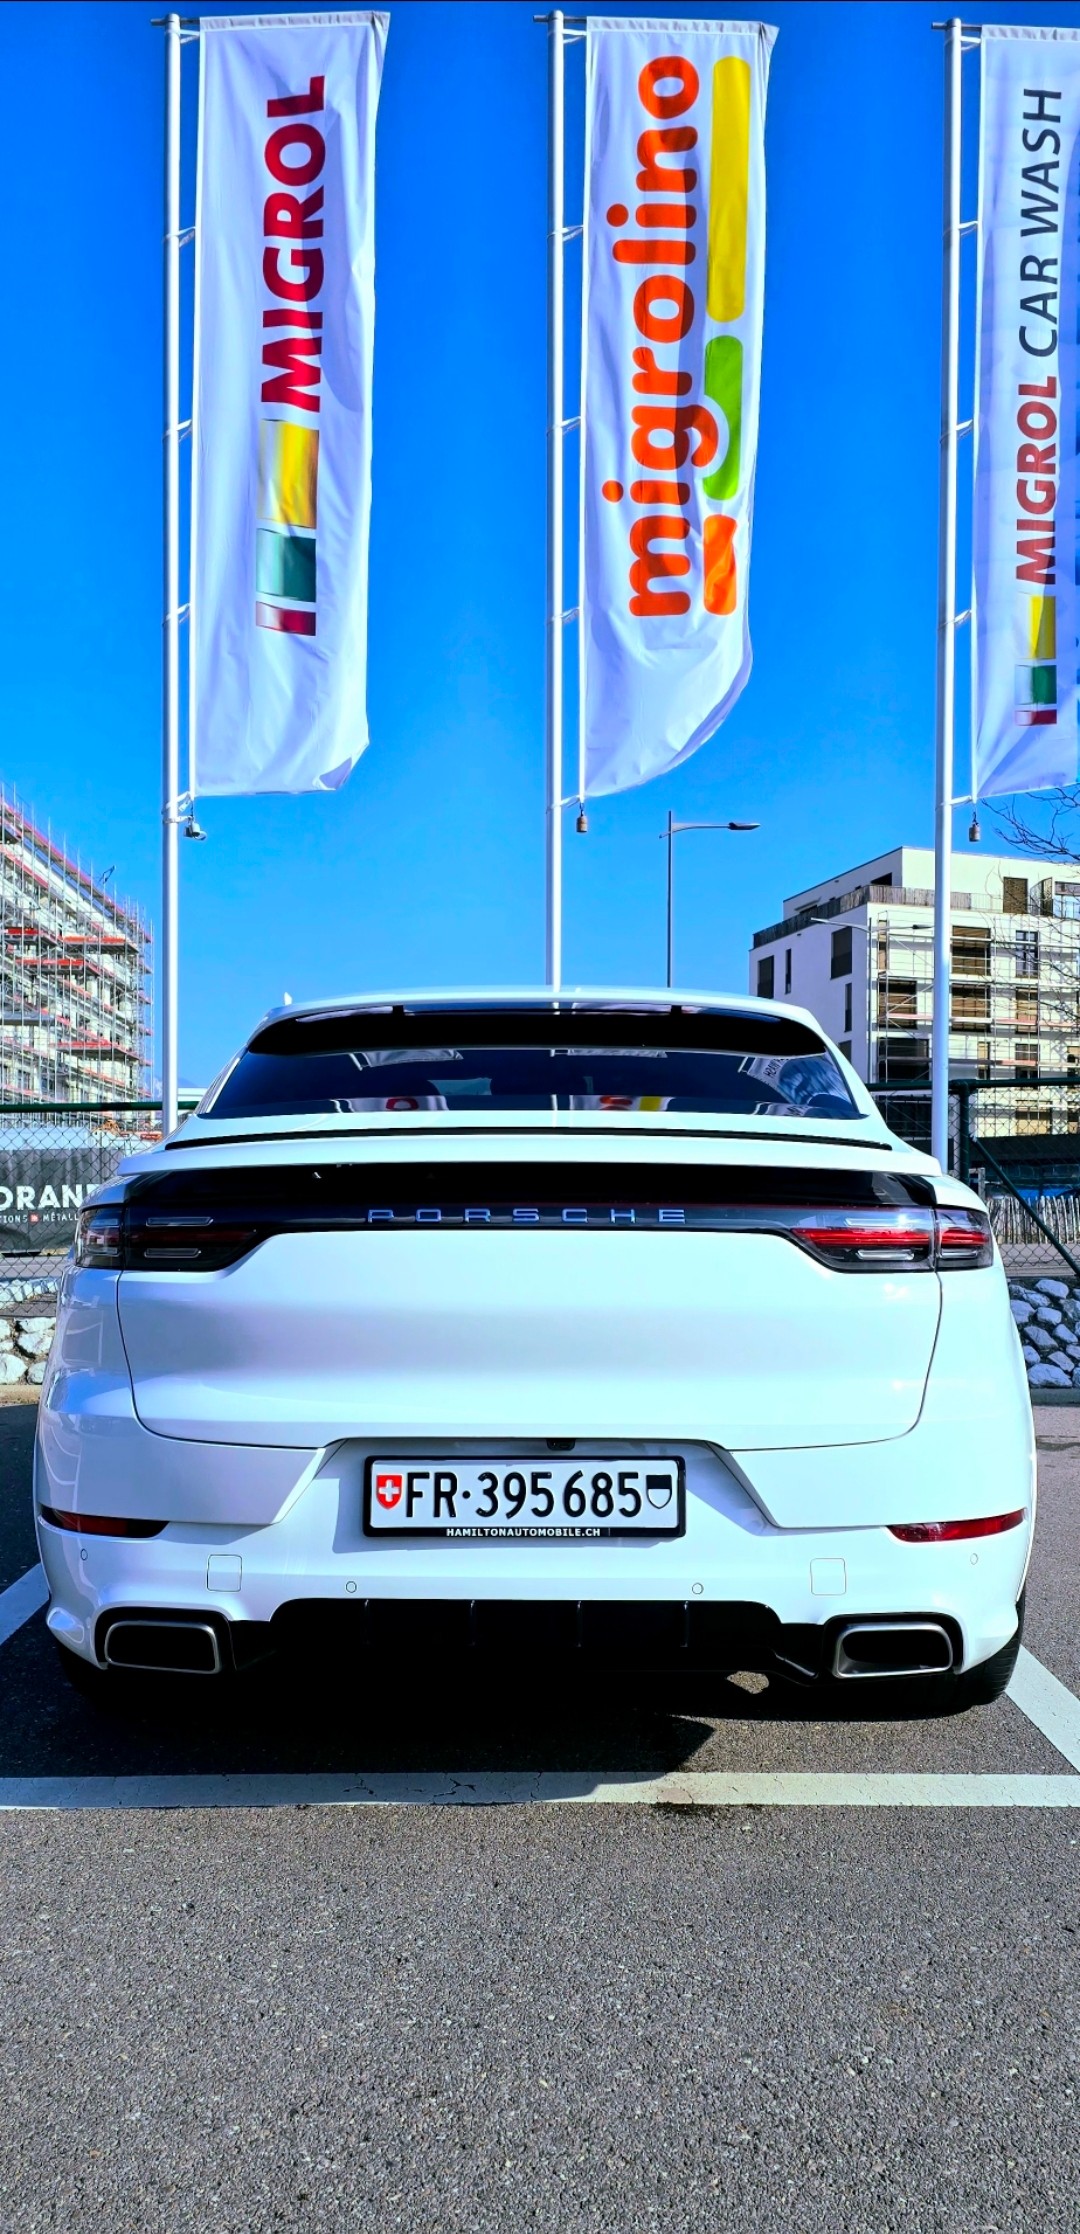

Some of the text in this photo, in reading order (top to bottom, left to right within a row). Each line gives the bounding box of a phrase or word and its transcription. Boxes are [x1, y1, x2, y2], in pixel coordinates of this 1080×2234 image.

[261, 75, 325, 413] MIGROL
[602, 56, 719, 617] migrolino
[1016, 88, 1062, 585] MIGROL CAR WASH
[367, 1208, 686, 1223] PORSCHE
[446, 1528, 601, 1537] HAMILTONAUTOMOBILE.CH
